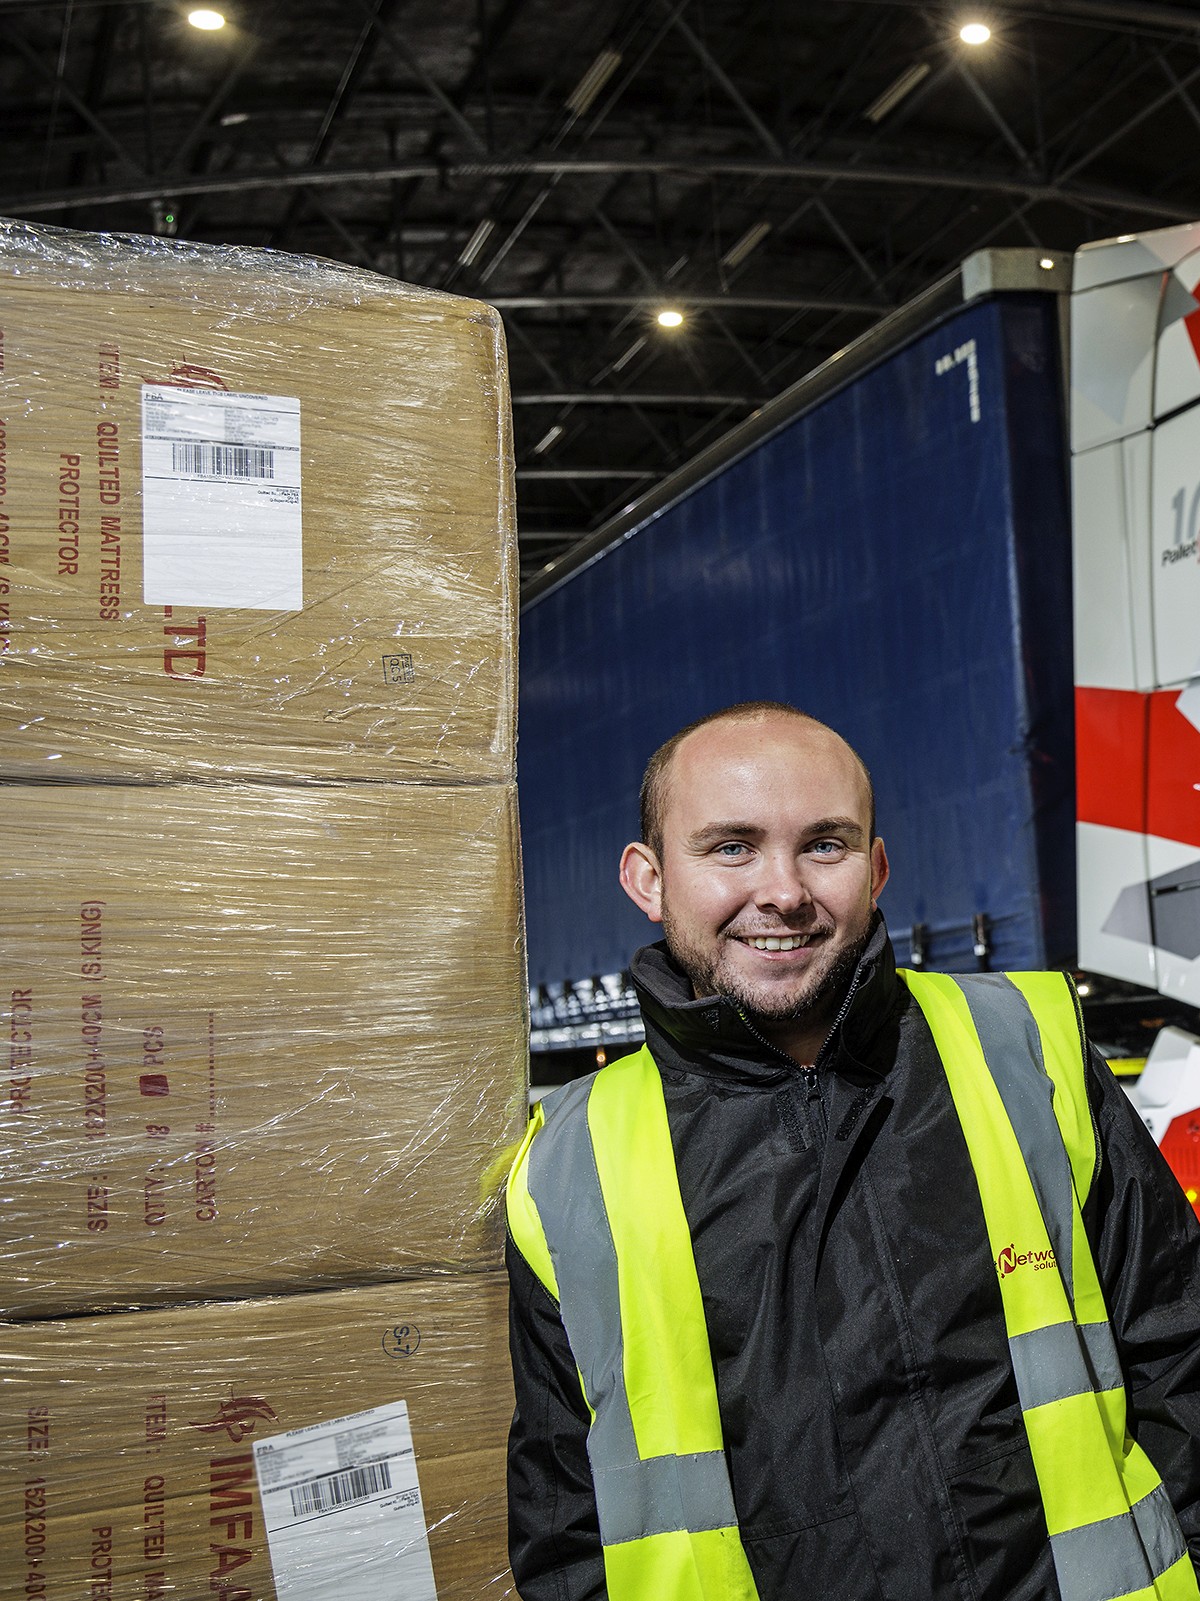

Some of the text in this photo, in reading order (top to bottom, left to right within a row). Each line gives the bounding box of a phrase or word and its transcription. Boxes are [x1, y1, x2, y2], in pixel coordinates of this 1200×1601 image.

[97, 421, 120, 505] QUILTED
[57, 453, 81, 576] PROTECTOR
[99, 516, 122, 621] MATTRESS
[163, 605, 207, 683] TD
[9, 987, 33, 1115] PROTECTOR
[142, 1025, 165, 1068] PCS
[143, 1475, 165, 1561] QUILTED
